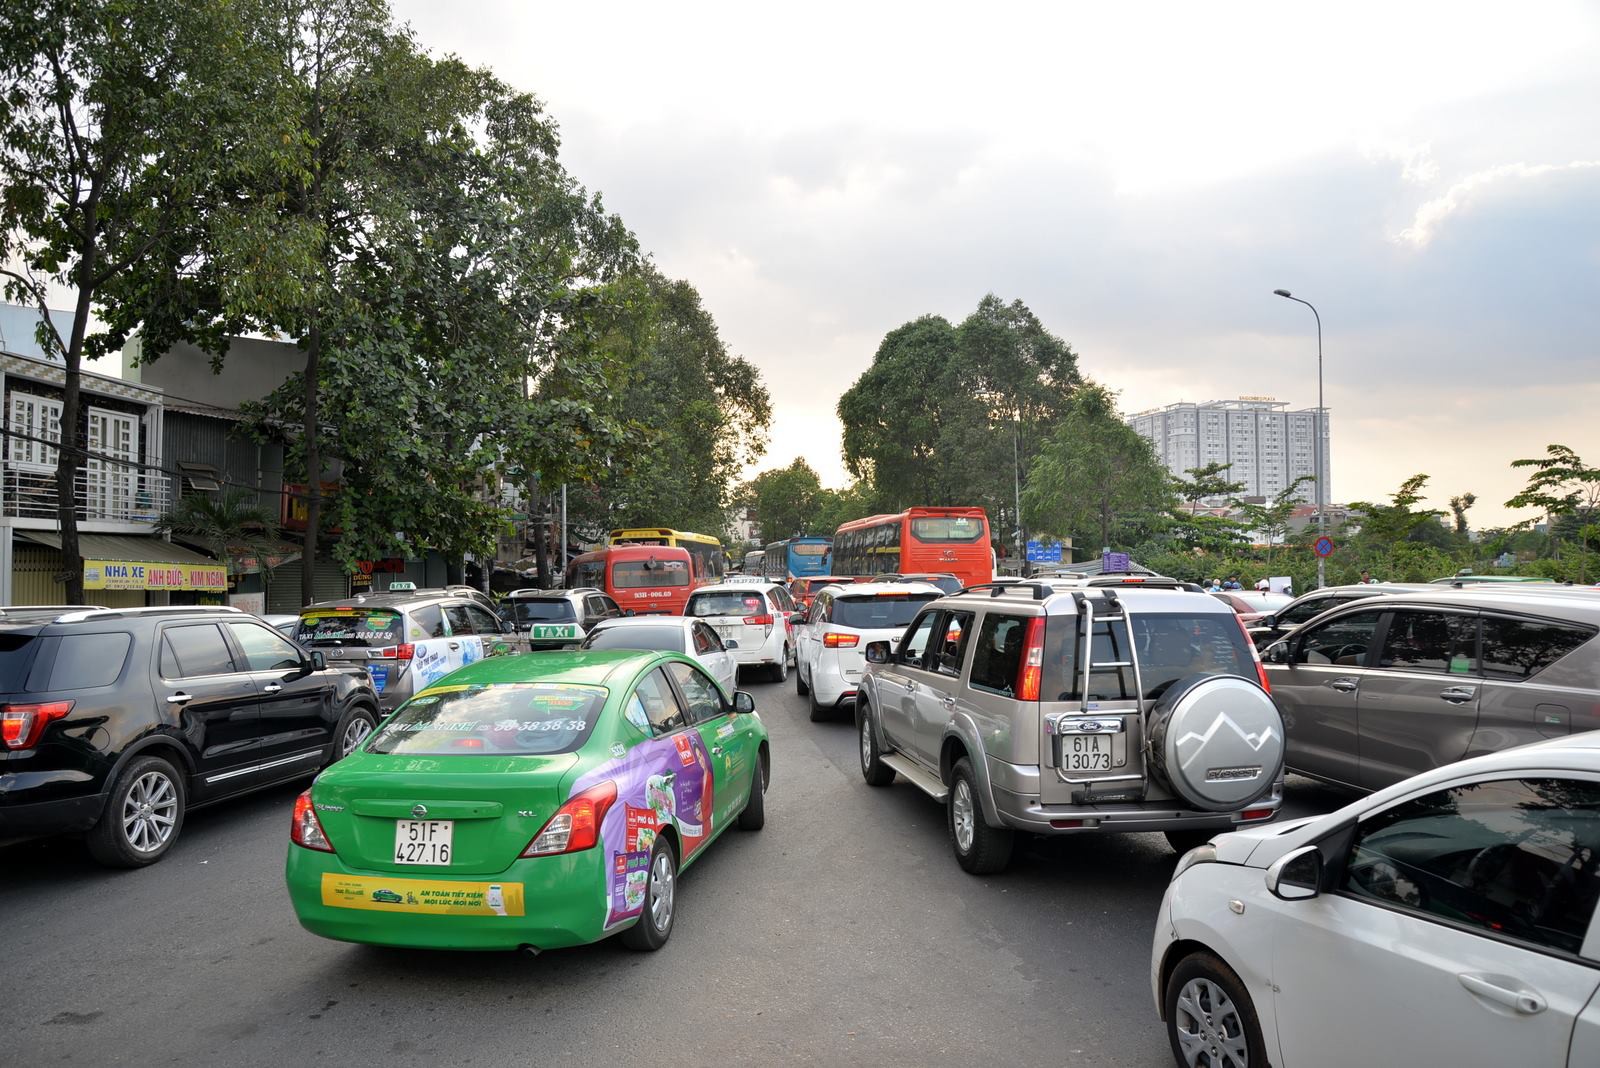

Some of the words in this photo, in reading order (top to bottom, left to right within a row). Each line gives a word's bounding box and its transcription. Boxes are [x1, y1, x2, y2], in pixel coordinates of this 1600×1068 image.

[131, 566, 145, 578] XE
[147, 569, 165, 586] ANH
[190, 570, 204, 587] KIM
[518, 721, 541, 731] 38
[542, 720, 562, 731] 38
[566, 720, 587, 731] 38
[1073, 737, 1100, 753] 61A
[1064, 753, 1110, 771] 130.73
[517, 810, 538, 818] XL
[409, 822, 439, 841] 51F
[396, 844, 449, 863] 427.16
